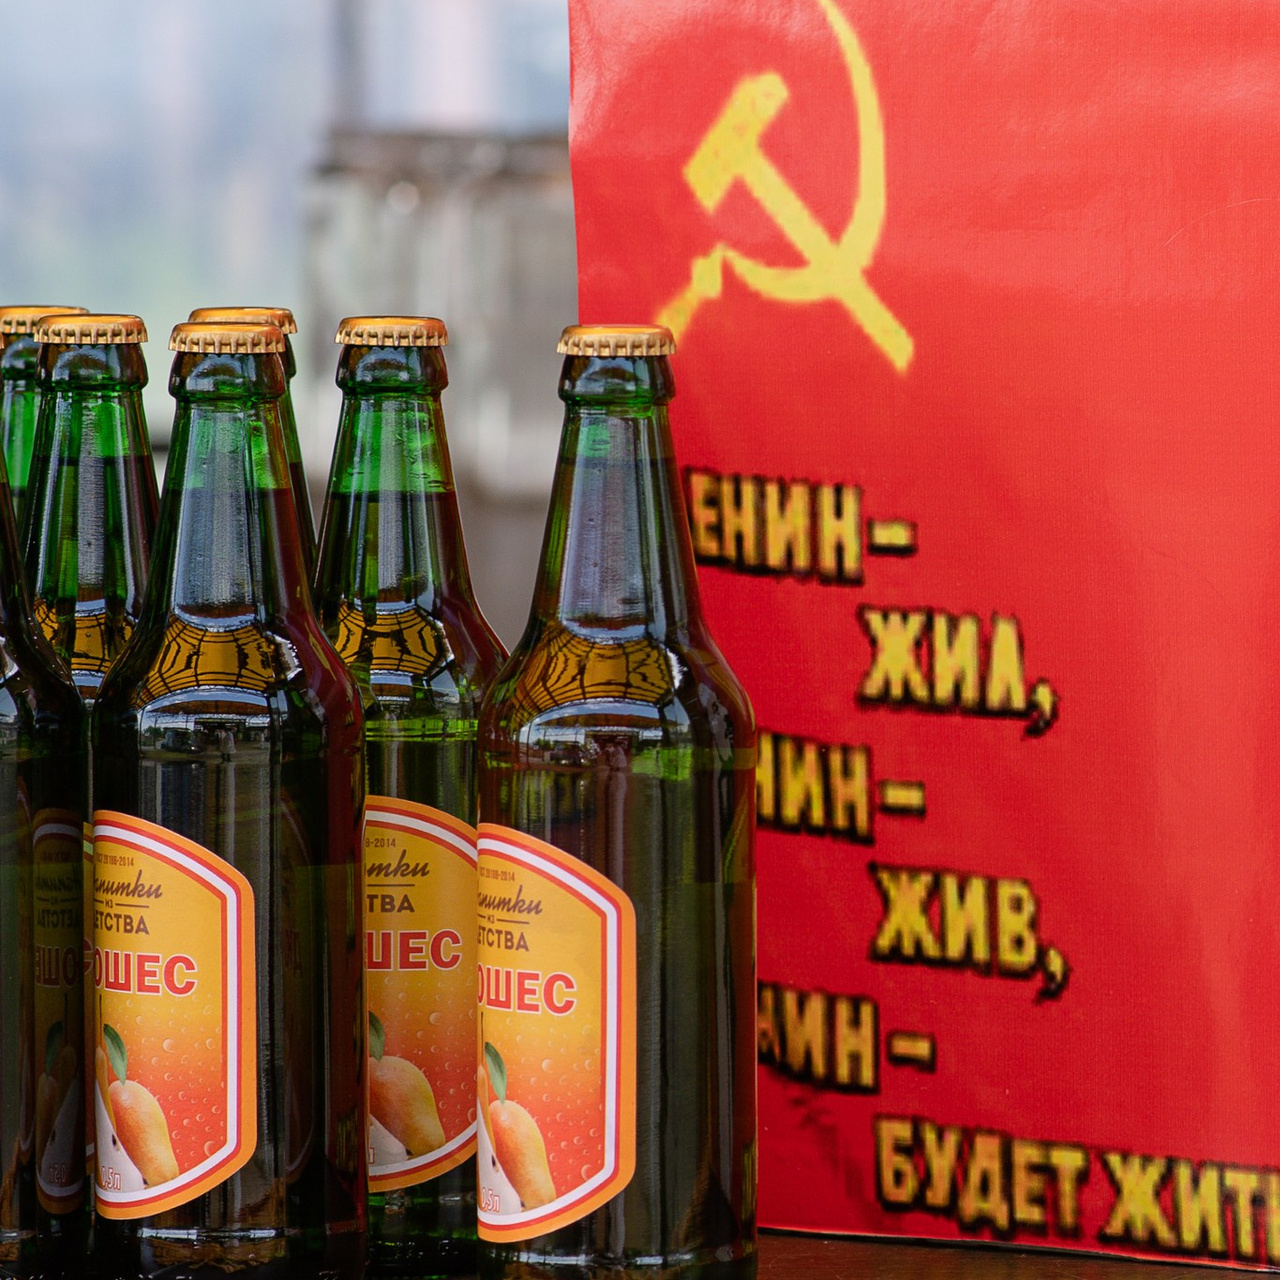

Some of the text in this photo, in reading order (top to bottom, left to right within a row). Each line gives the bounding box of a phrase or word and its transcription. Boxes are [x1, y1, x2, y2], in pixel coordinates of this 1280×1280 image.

[684, 467, 916, 585] ЕНИН-
[857, 604, 1059, 739] ЖИЛ,
[869, 861, 1069, 1002] ЖИВ,
[875, 1115, 1088, 1238] БУДЕТ
